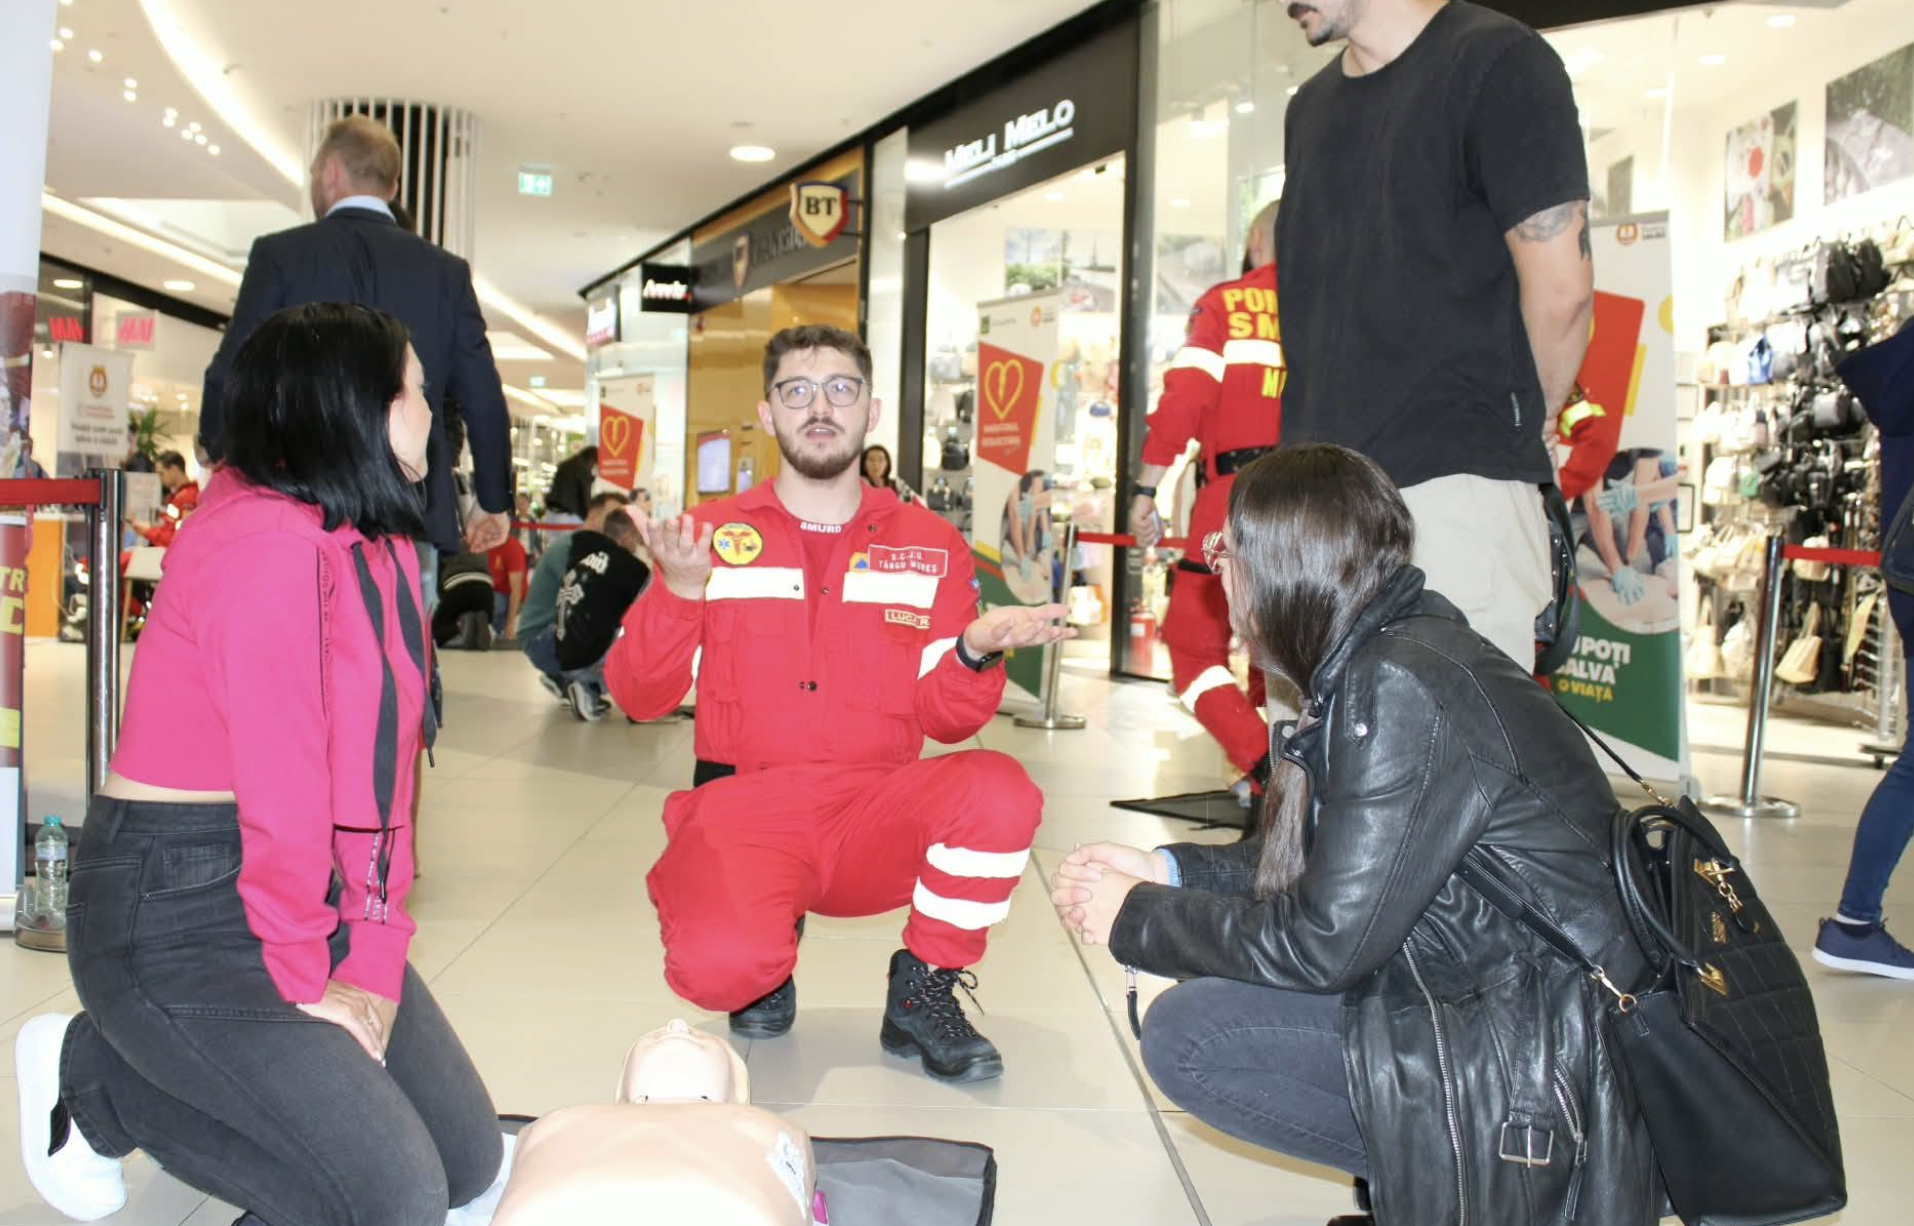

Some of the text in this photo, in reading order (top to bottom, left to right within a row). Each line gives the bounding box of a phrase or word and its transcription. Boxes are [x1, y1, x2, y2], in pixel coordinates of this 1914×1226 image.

[1003, 98, 1076, 151] MELO
[805, 196, 838, 216] BT
[1558, 678, 1570, 693] O
